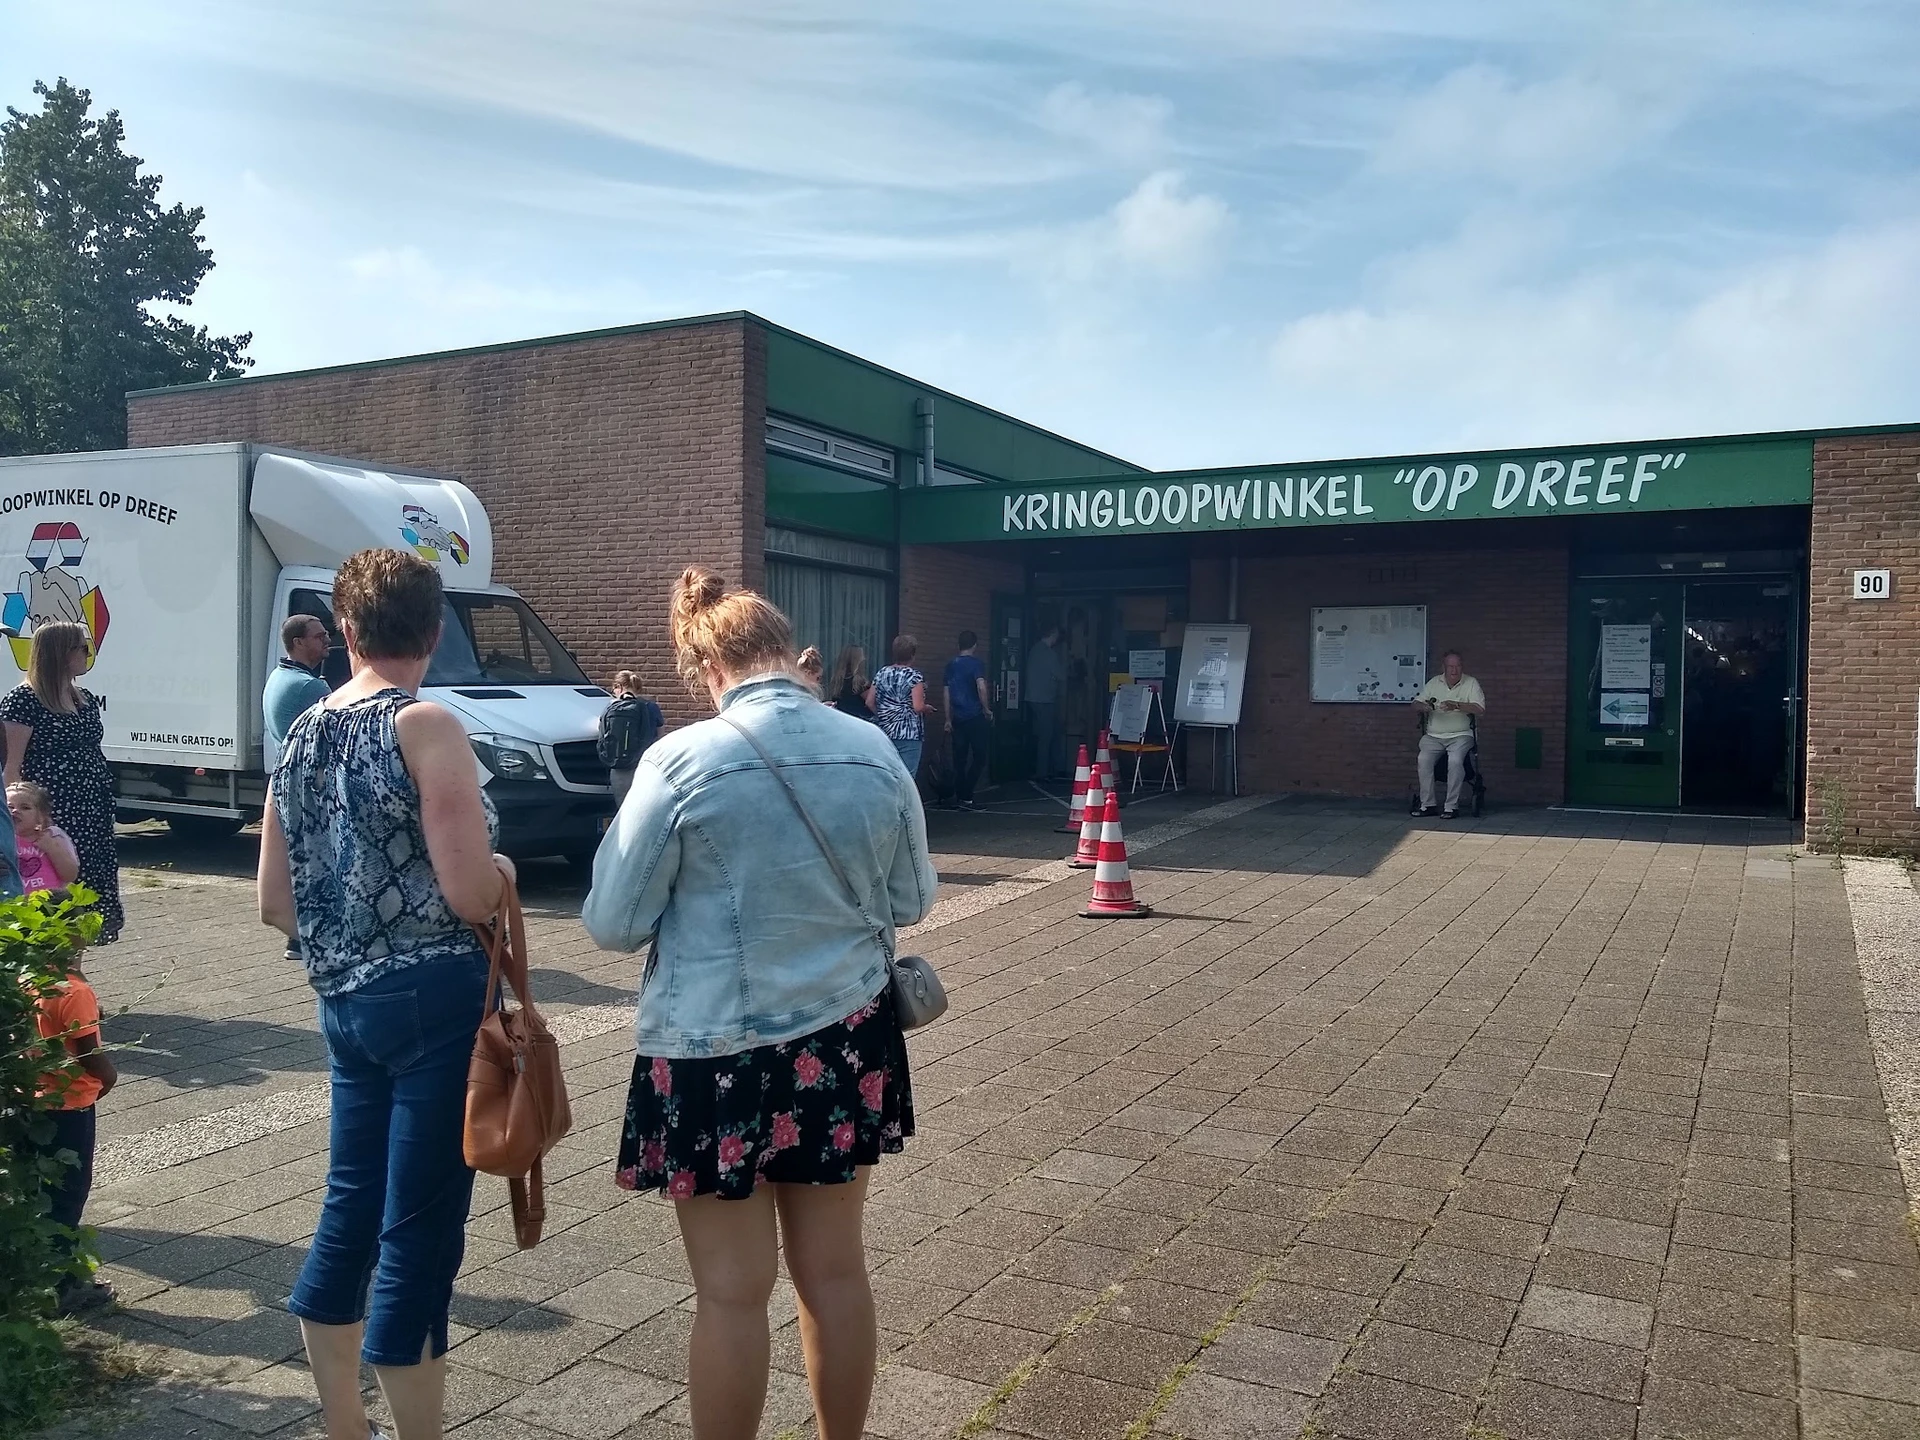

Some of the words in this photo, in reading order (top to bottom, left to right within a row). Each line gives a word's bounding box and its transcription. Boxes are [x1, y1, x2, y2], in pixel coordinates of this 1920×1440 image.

[99, 490, 121, 509] OP
[125, 495, 178, 526] DREEF
[1003, 474, 1374, 533] KRINGLOOPWINKEL
[1860, 576, 1883, 593] 90
[130, 732, 148, 742] WIJ
[150, 733, 179, 744] HALEN
[181, 735, 216, 747] GRATIS
[217, 737, 234, 748] OP!
